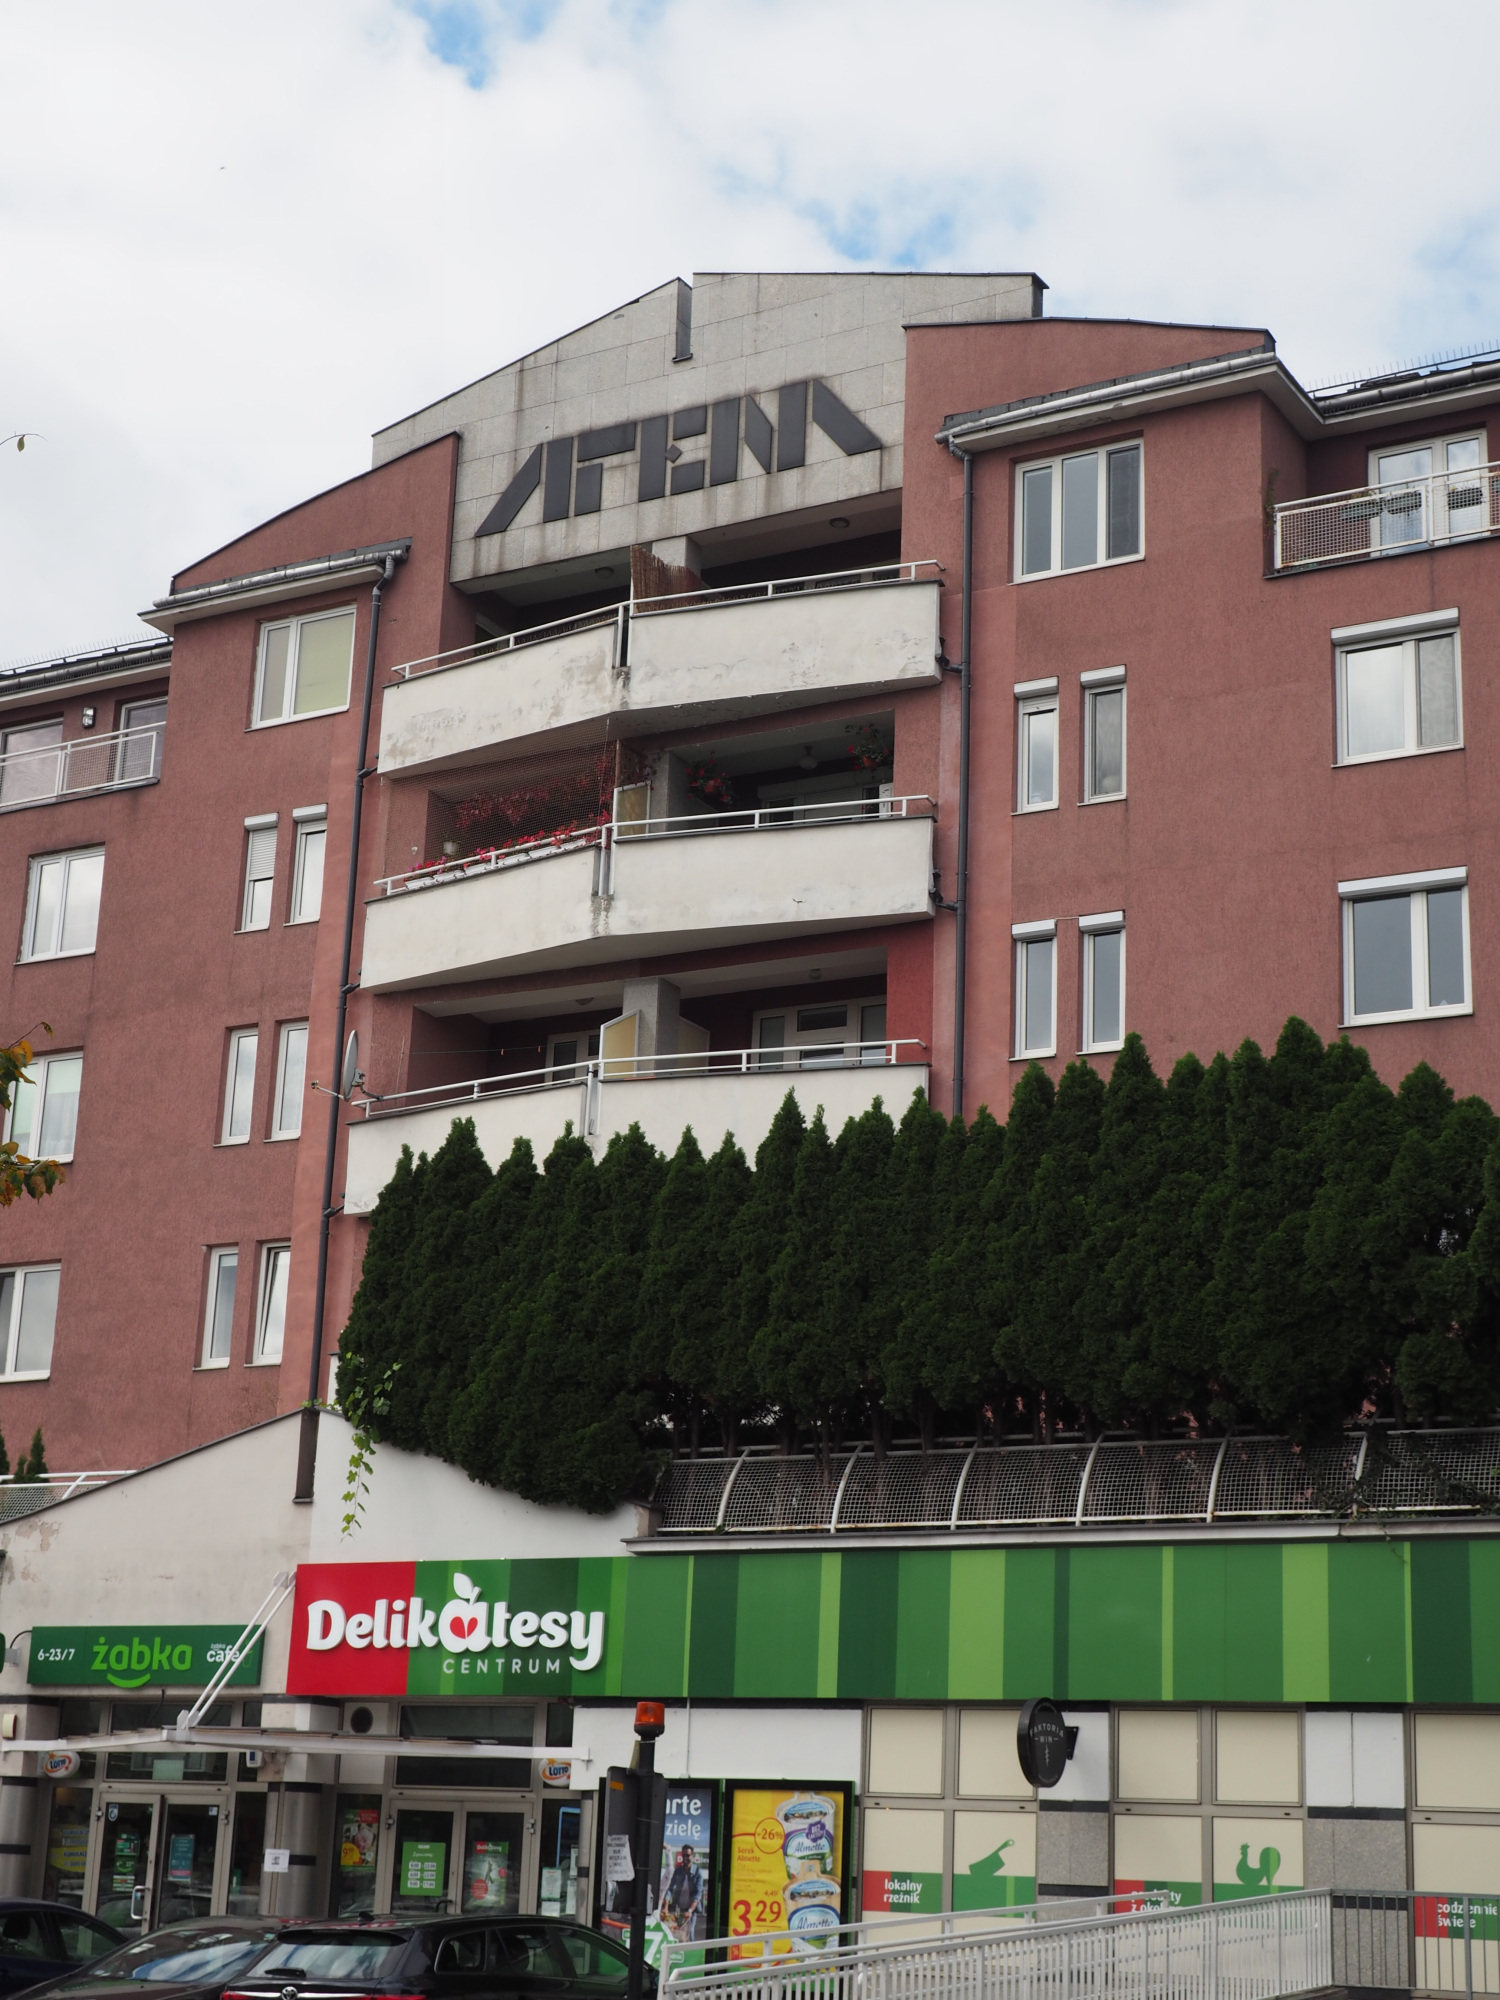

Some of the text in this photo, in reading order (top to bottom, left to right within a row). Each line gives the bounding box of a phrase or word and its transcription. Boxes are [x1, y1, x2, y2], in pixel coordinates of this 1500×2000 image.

[306, 1596, 605, 1671] Delikatesy
[37, 1648, 76, 1661] 6-23/7
[91, 1636, 193, 1671] żabka
[443, 1658, 561, 1674] CENTRUM
[1030, 1723, 1064, 1738] FAKTORIA
[548, 1765, 569, 1777] LOTTO
[884, 1878, 922, 1893] lokalny
[883, 1893, 920, 1904] rzeźnik
[1437, 1901, 1498, 1915] codzennie
[1437, 1915, 1476, 1928] świee
